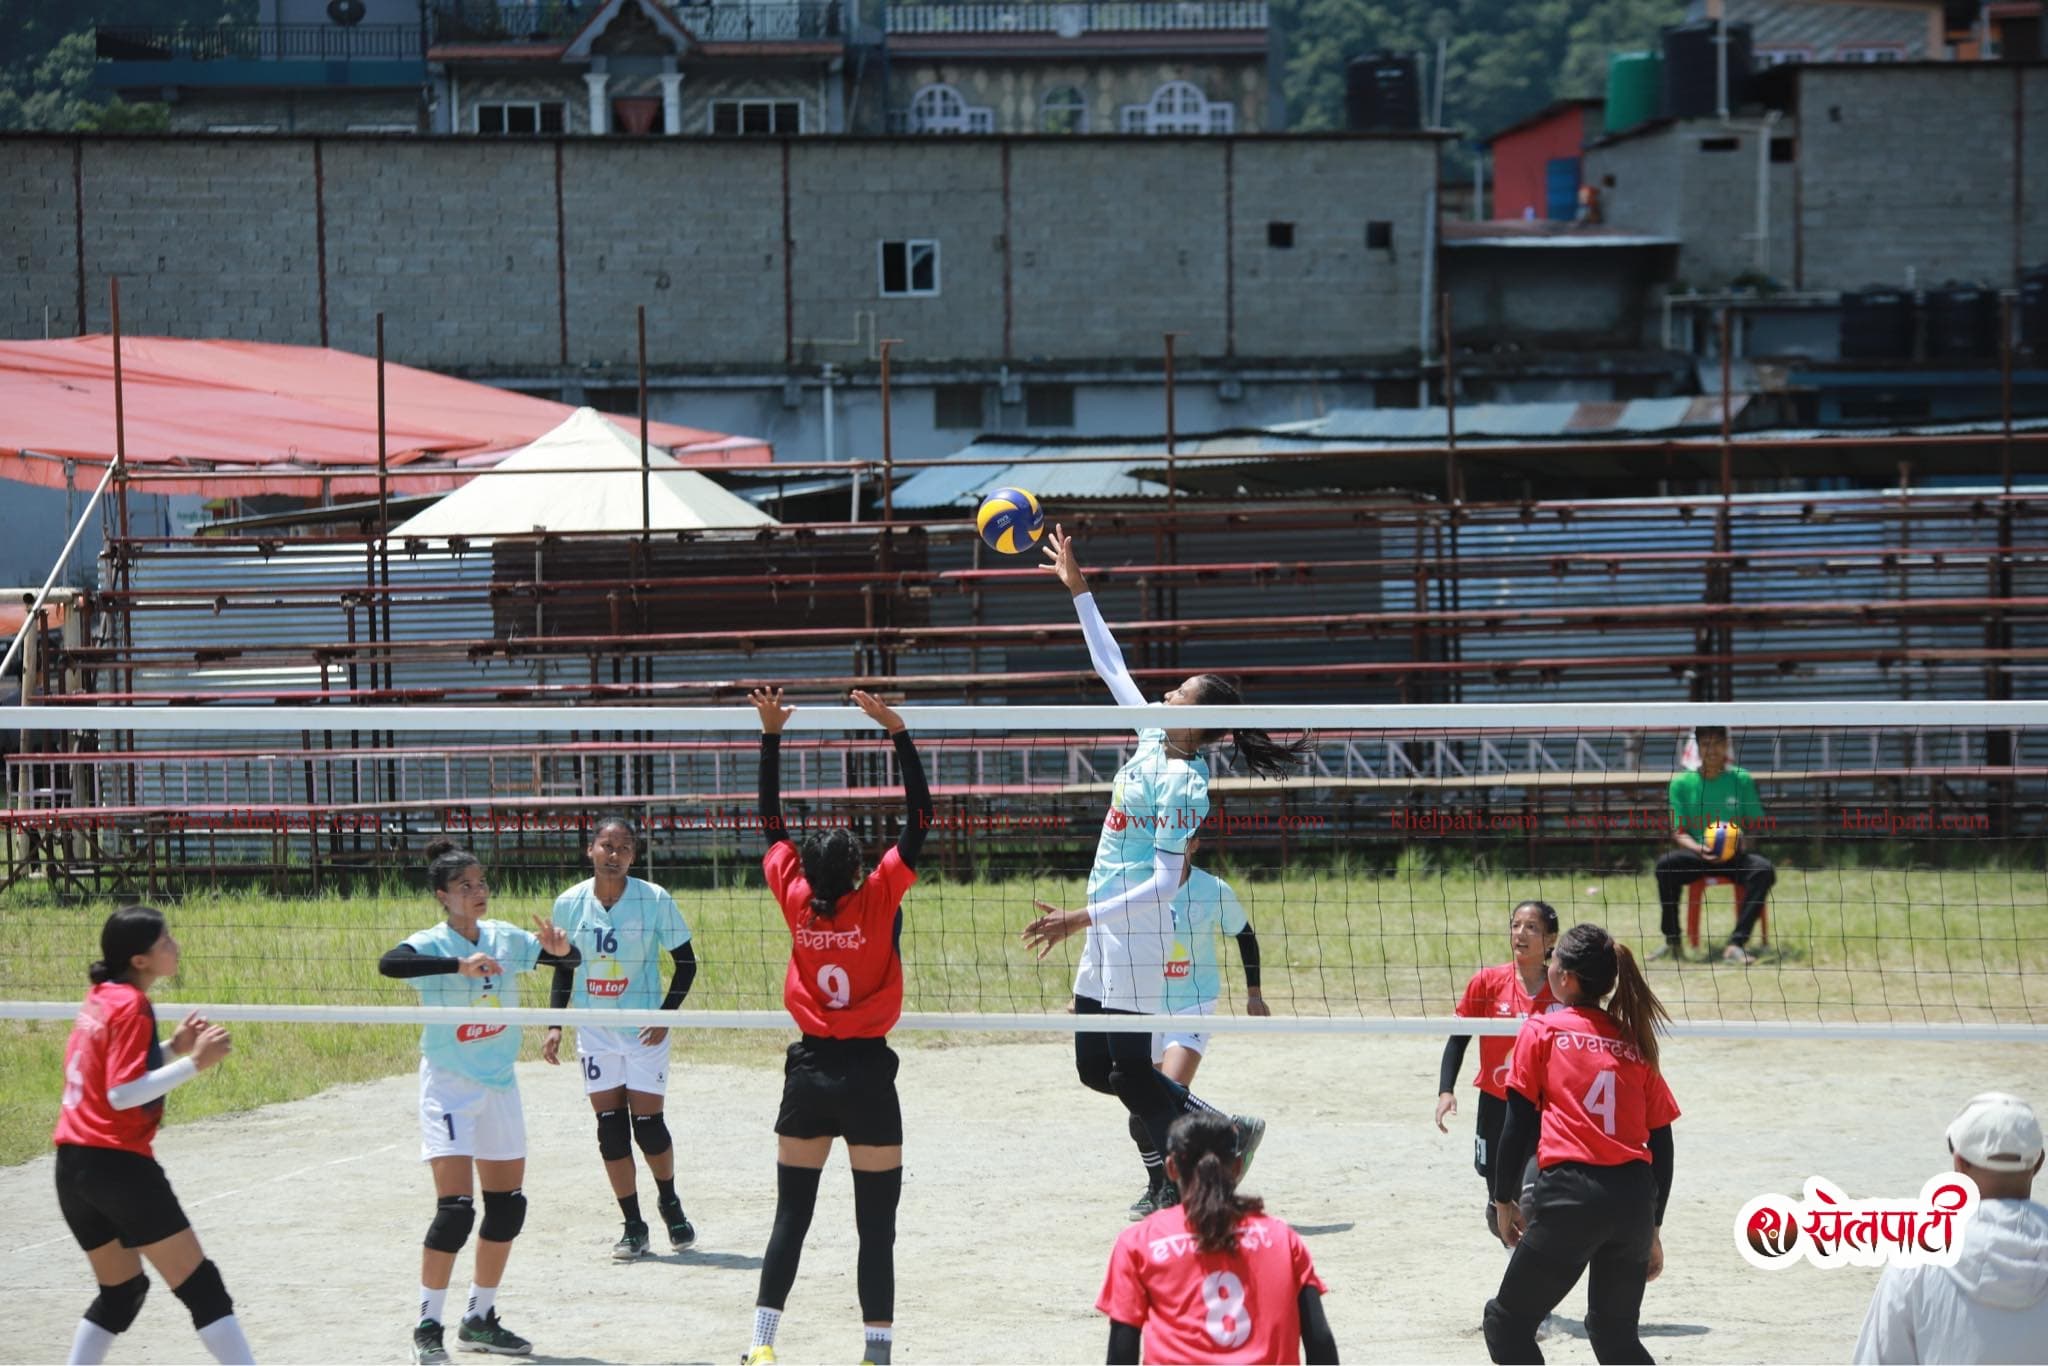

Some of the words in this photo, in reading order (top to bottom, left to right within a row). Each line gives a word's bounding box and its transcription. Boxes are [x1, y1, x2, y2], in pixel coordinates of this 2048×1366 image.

[593, 927, 618, 954] 16
[816, 964, 851, 1009] 9
[1582, 1069, 1616, 1136] 4
[443, 1112, 456, 1141] 1
[1202, 1270, 1252, 1348] 8
